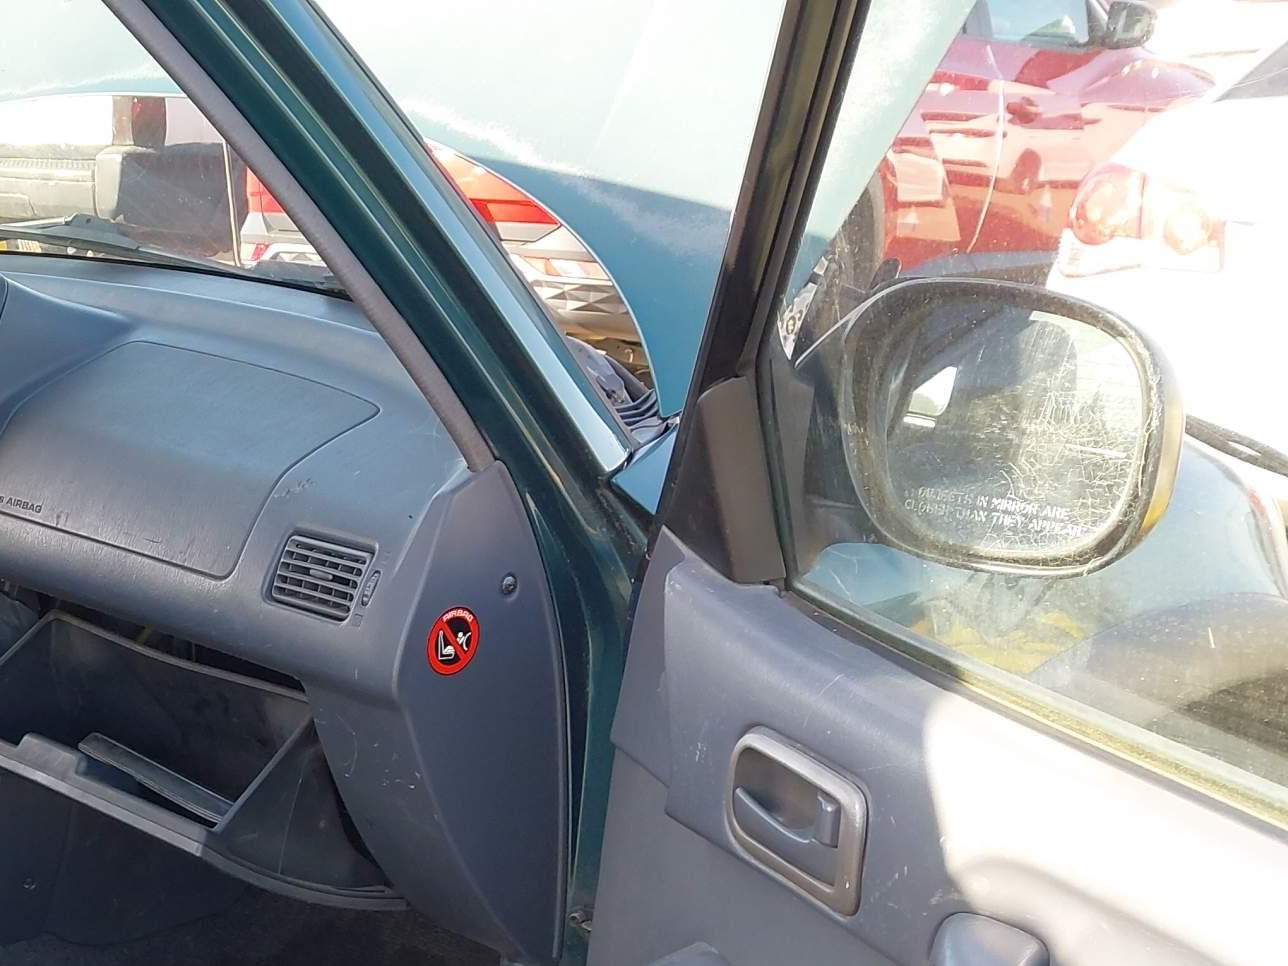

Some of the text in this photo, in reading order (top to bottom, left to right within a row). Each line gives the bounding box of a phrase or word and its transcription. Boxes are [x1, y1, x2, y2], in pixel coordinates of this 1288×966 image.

[6, 496, 43, 514] AIRBAG
[990, 497, 1040, 515] MIRROR
[1040, 505, 1072, 520] ARE
[991, 512, 1025, 530] THEY
